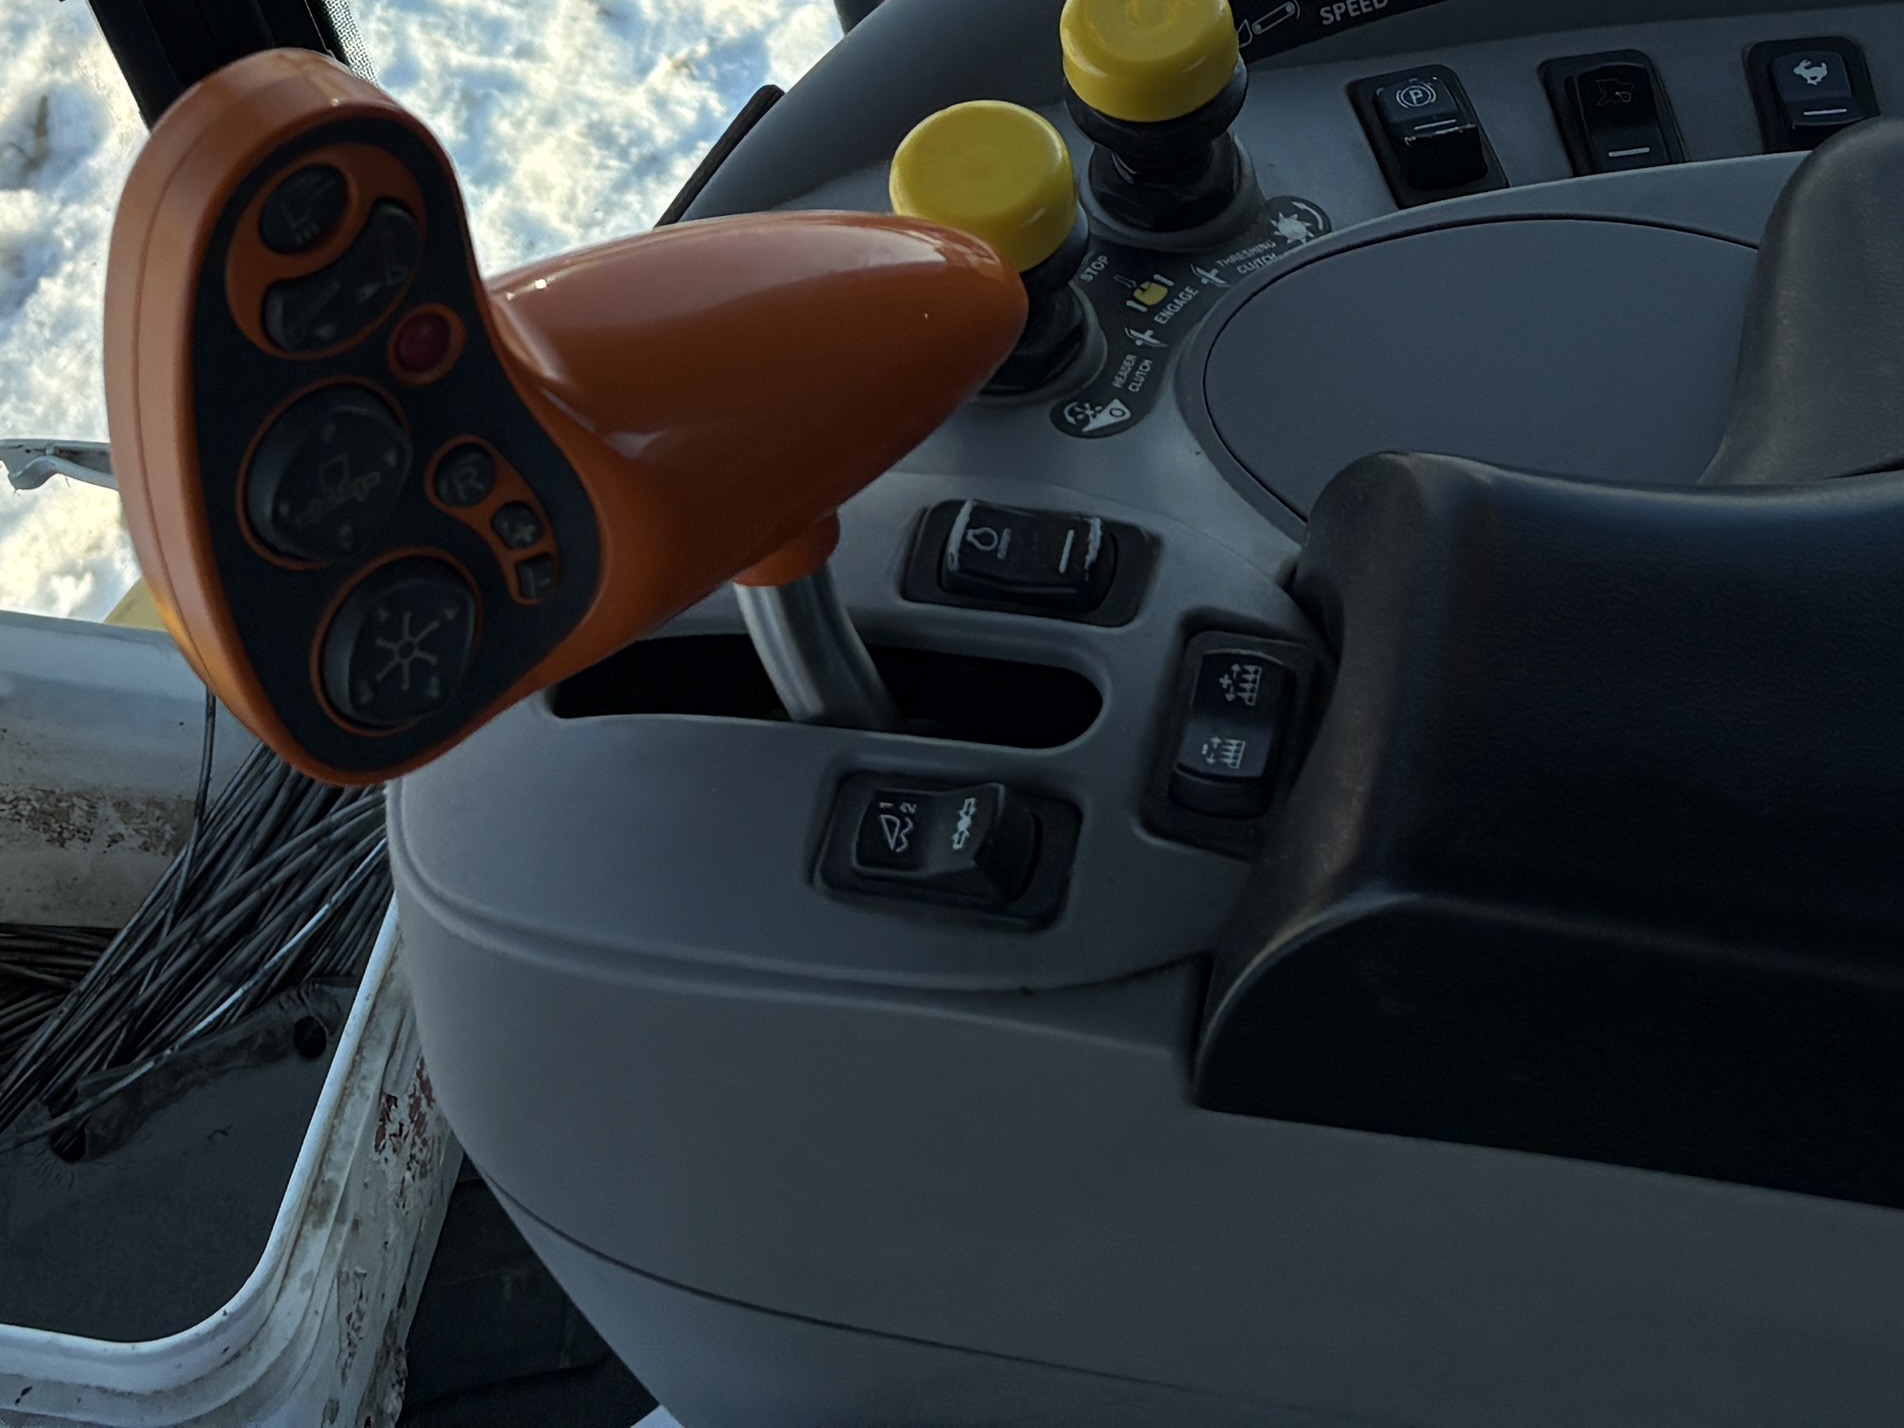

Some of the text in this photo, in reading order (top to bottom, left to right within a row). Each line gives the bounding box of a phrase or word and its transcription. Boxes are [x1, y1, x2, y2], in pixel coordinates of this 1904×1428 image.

[1408, 89, 1424, 105] P
[1079, 254, 1111, 283] STOP
[1153, 285, 1199, 325] ENGAGE
